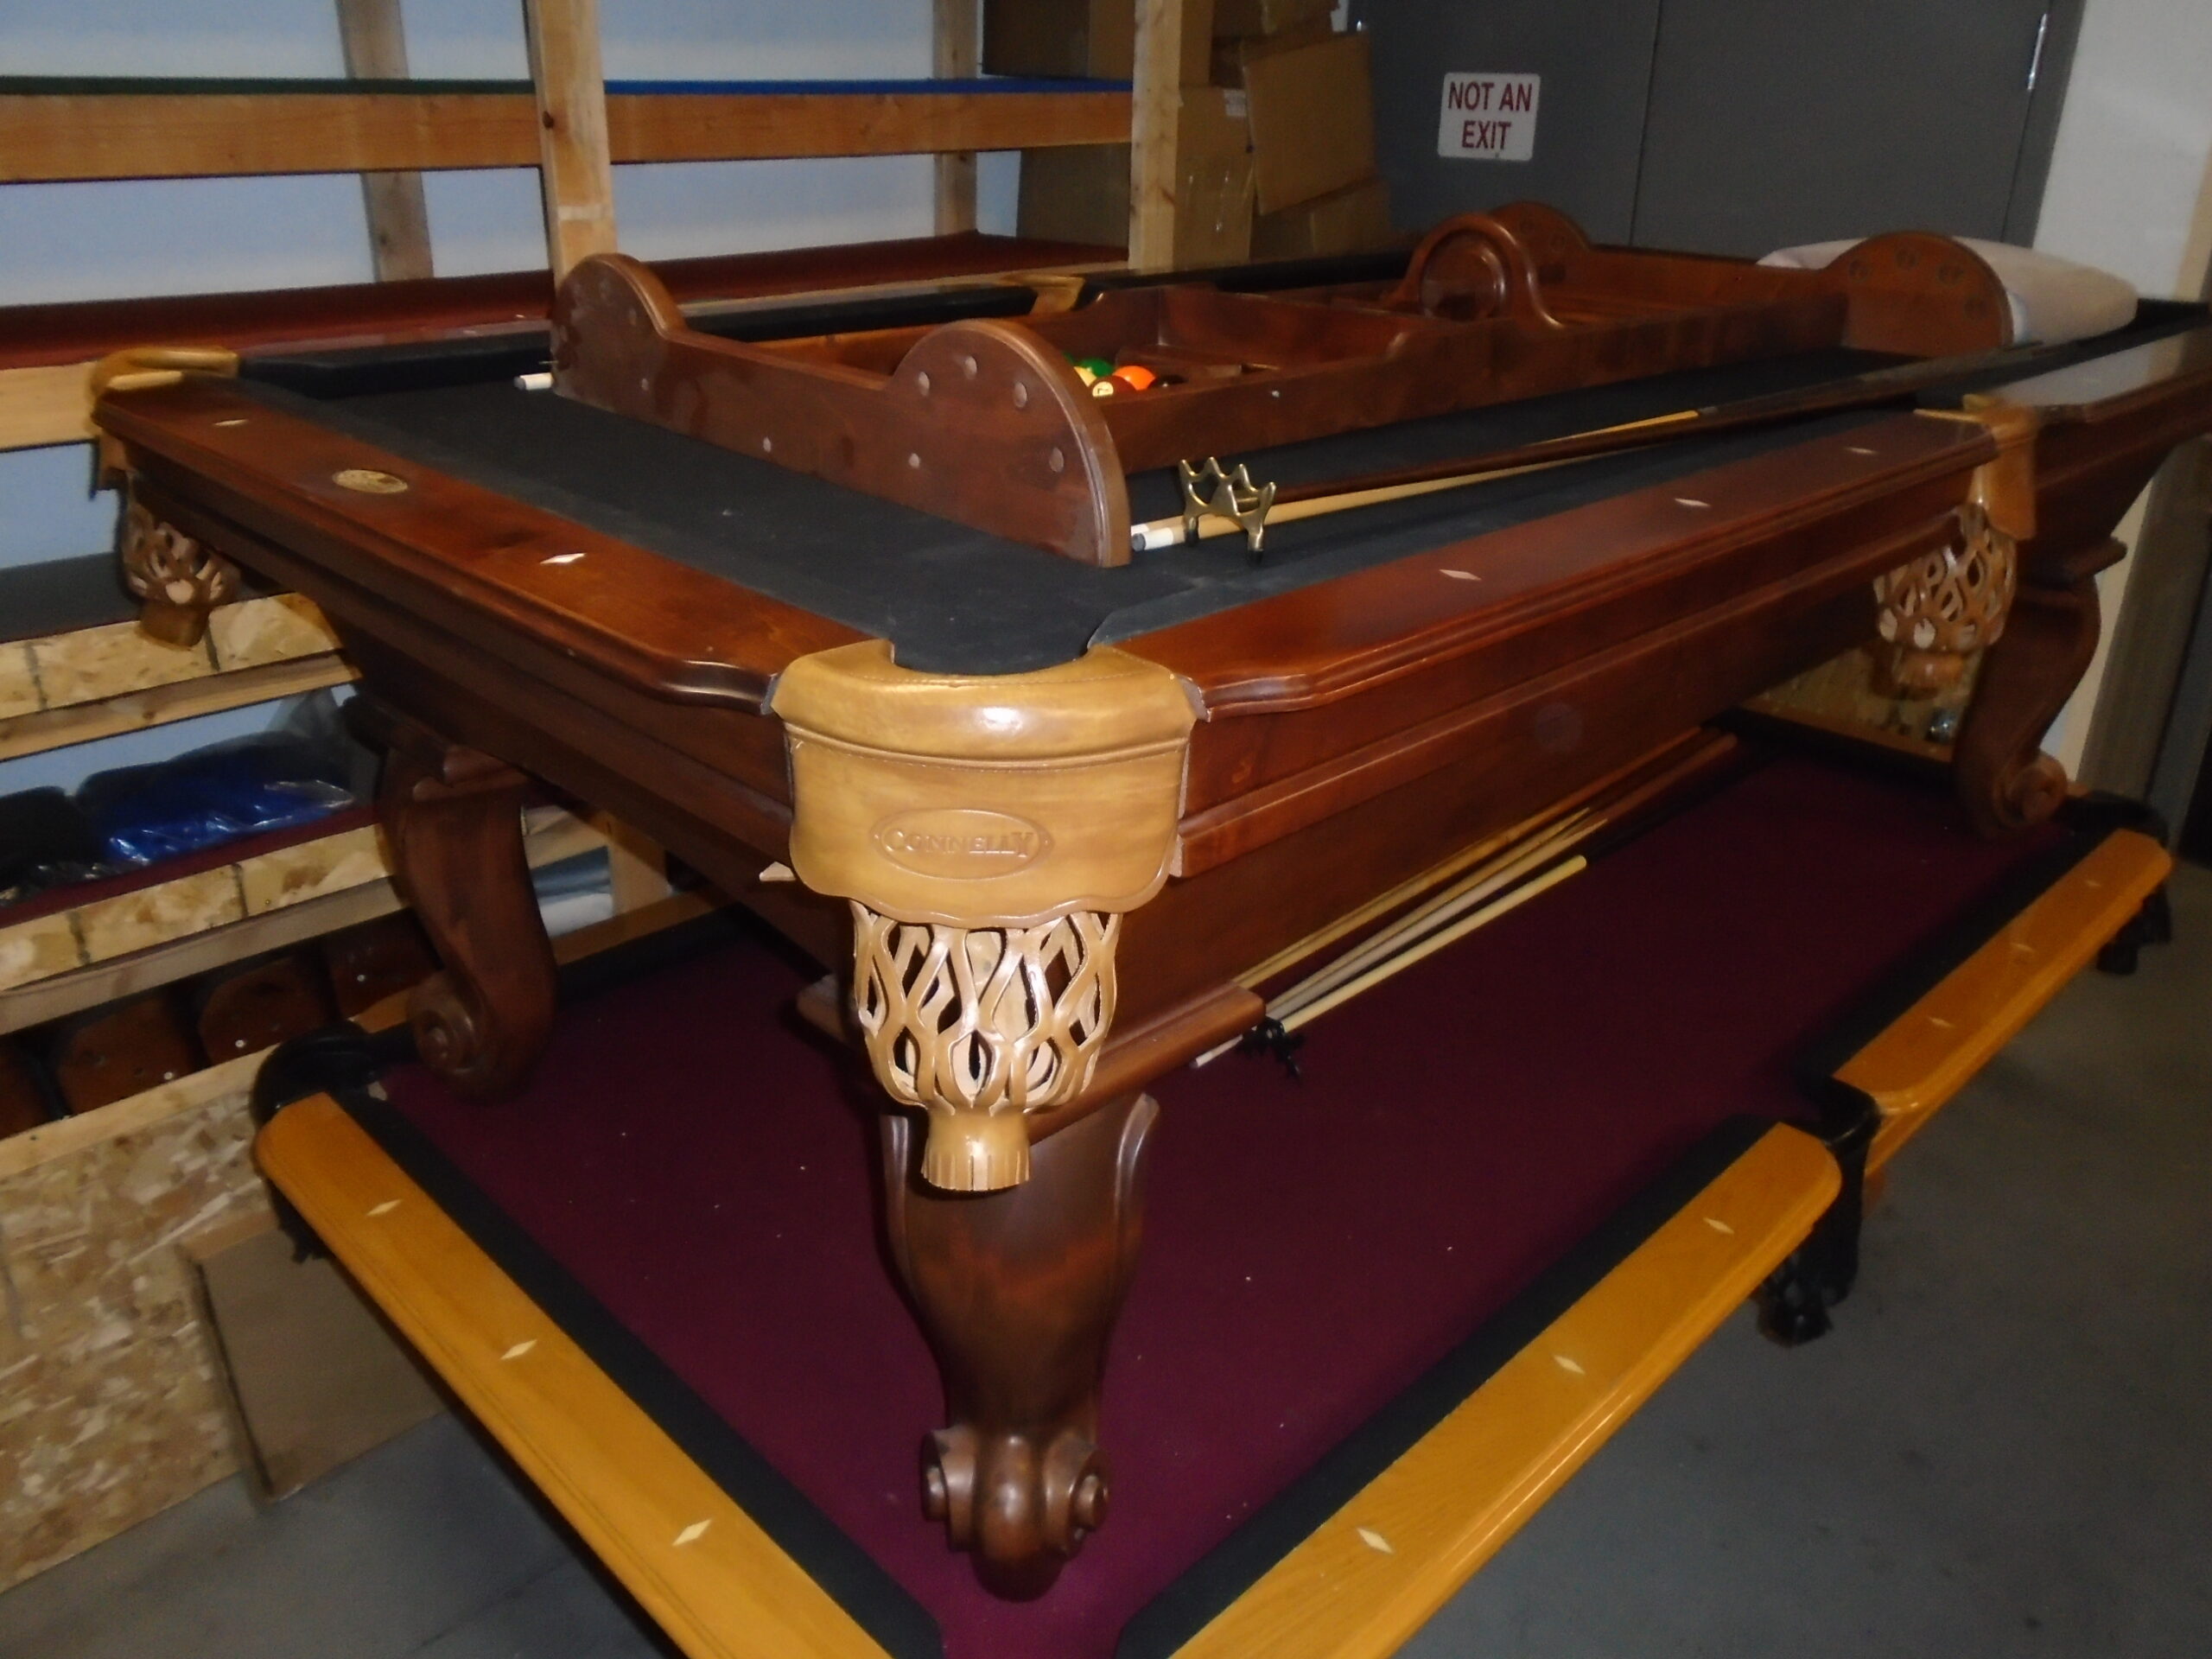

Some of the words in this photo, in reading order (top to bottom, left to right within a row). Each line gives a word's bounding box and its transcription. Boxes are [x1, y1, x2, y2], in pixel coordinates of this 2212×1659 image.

[1448, 81, 1495, 111] NOT
[1499, 83, 1532, 111] AN
[1462, 120, 1511, 149] EXIT
[881, 828, 1033, 858] CONNELLY
